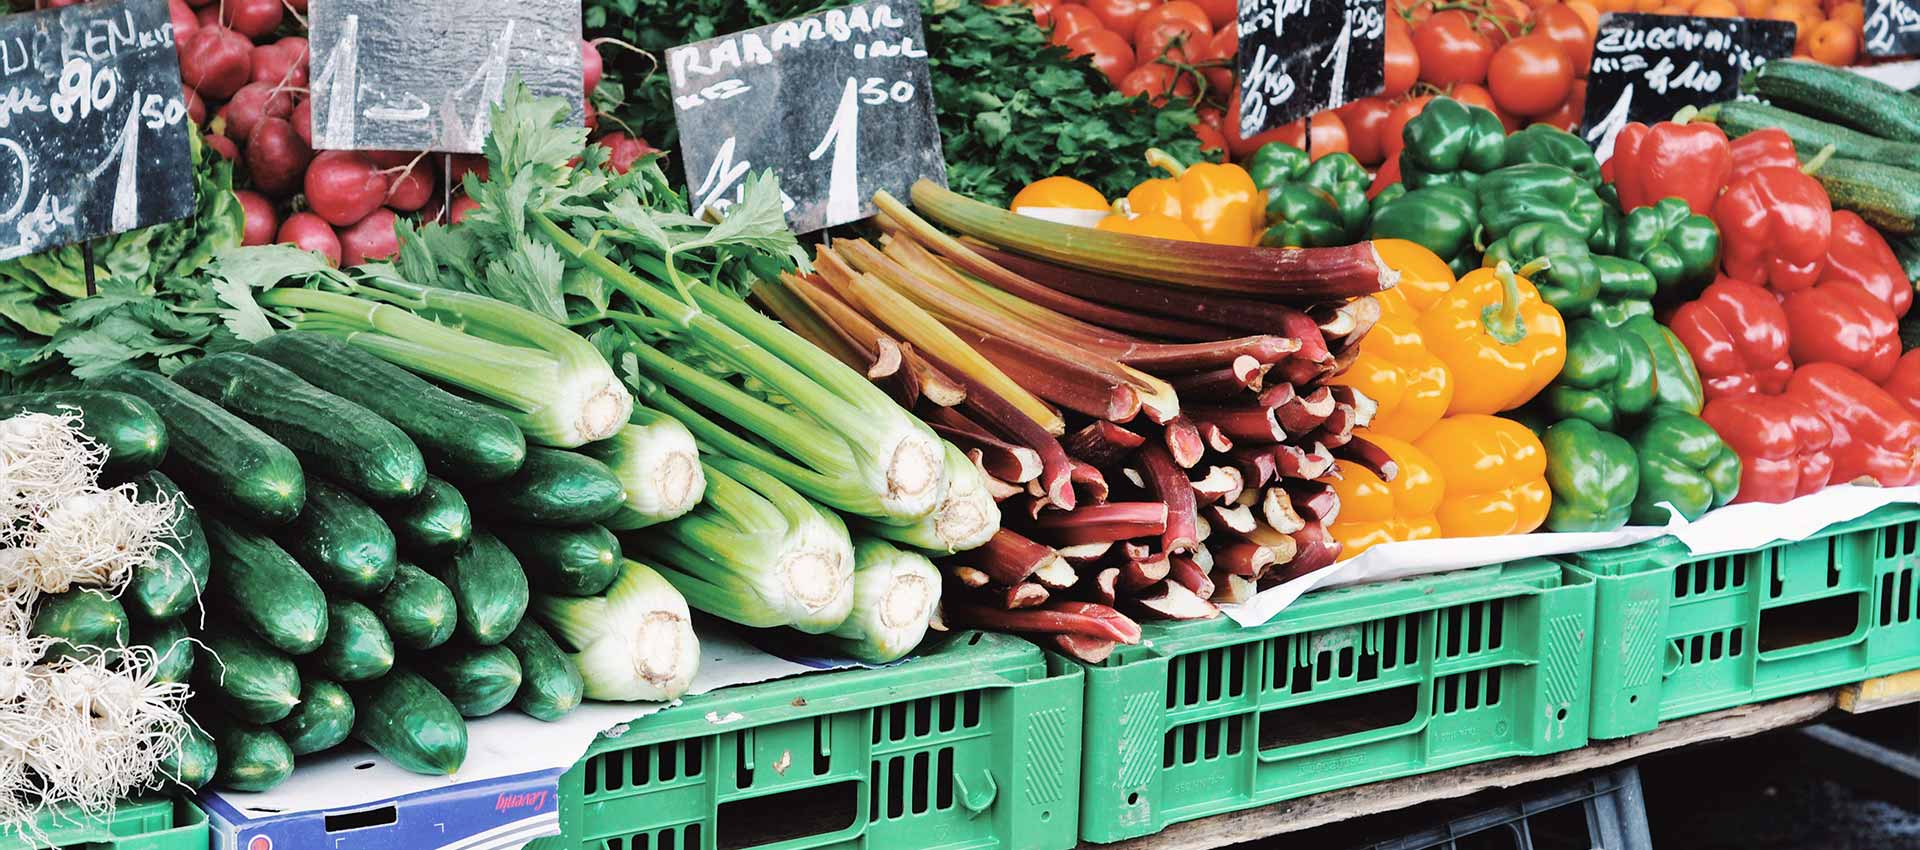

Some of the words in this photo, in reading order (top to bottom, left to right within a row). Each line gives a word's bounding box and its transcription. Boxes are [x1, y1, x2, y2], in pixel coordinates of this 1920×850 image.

[1321, 9, 1352, 110] 1
[141, 94, 188, 129] 50
[809, 76, 860, 224] 1
[859, 77, 915, 105] 50
